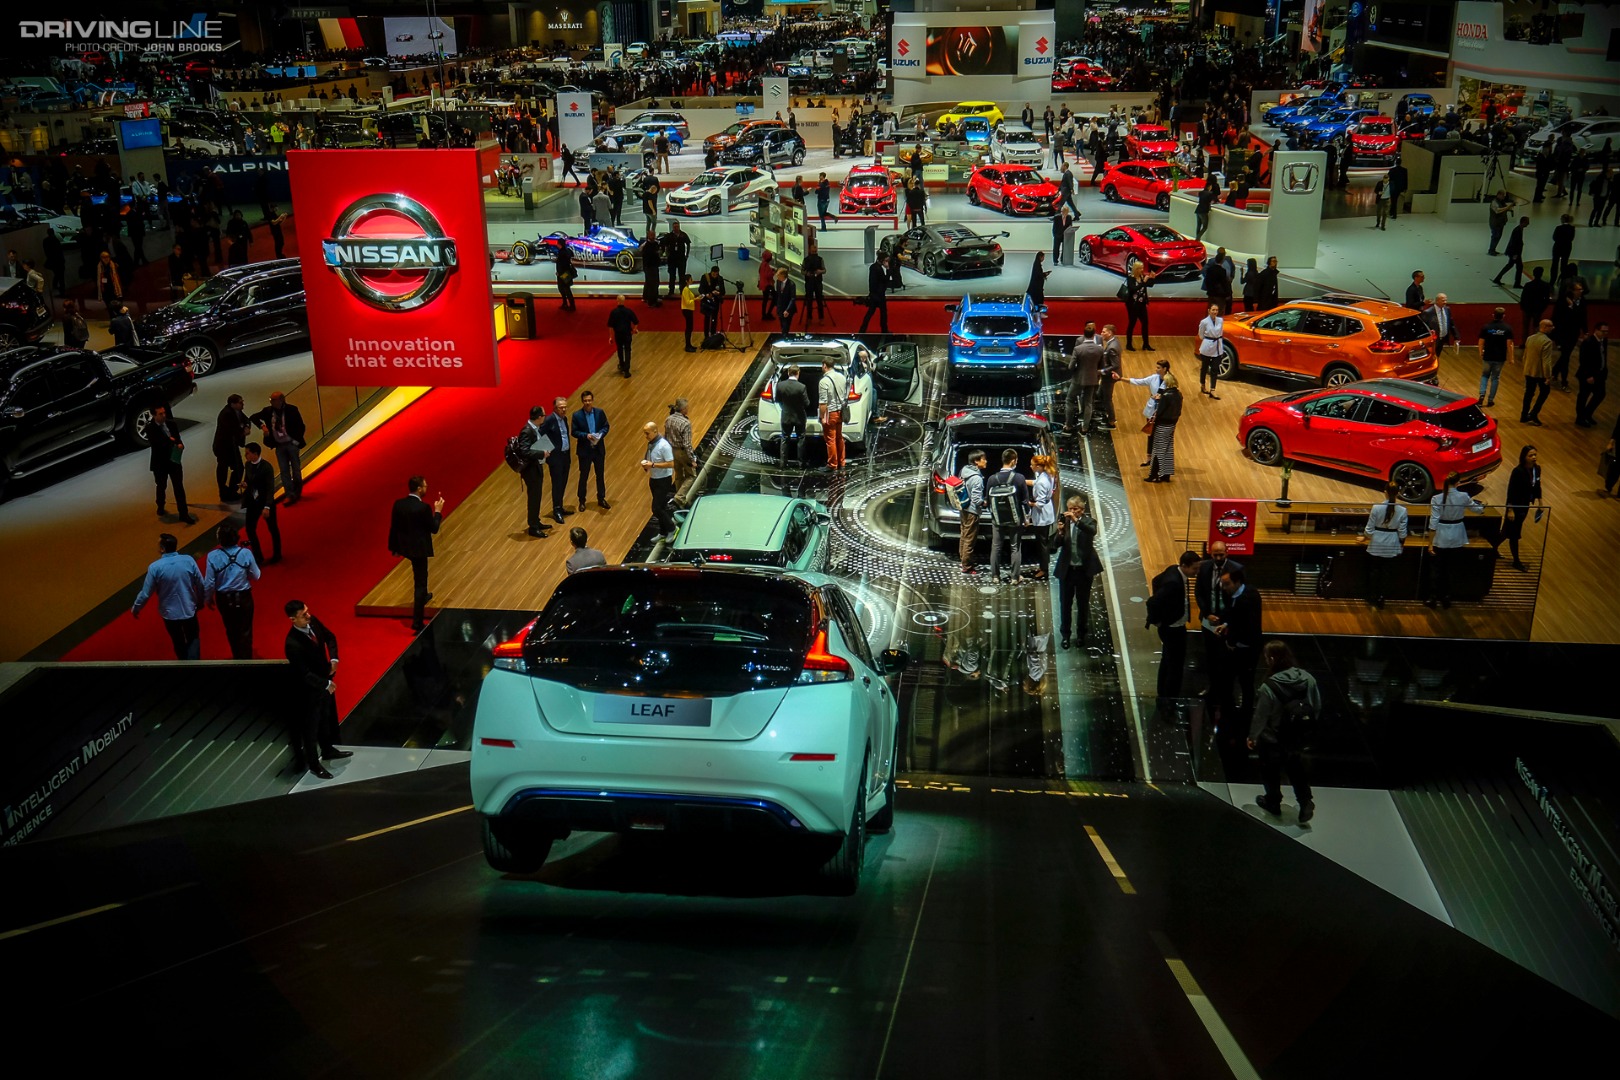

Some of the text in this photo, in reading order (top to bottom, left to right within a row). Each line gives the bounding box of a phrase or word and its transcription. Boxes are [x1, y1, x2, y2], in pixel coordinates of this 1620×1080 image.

[1456, 23, 1488, 39] HONDA
[1024, 57, 1053, 65] SUZUK
[335, 245, 441, 263] NISSAN
[348, 337, 456, 351] Innovation
[344, 353, 464, 368] that excites
[631, 703, 676, 718] LEAF
[3, 711, 134, 830] INTELLIGENT MOBILITY
